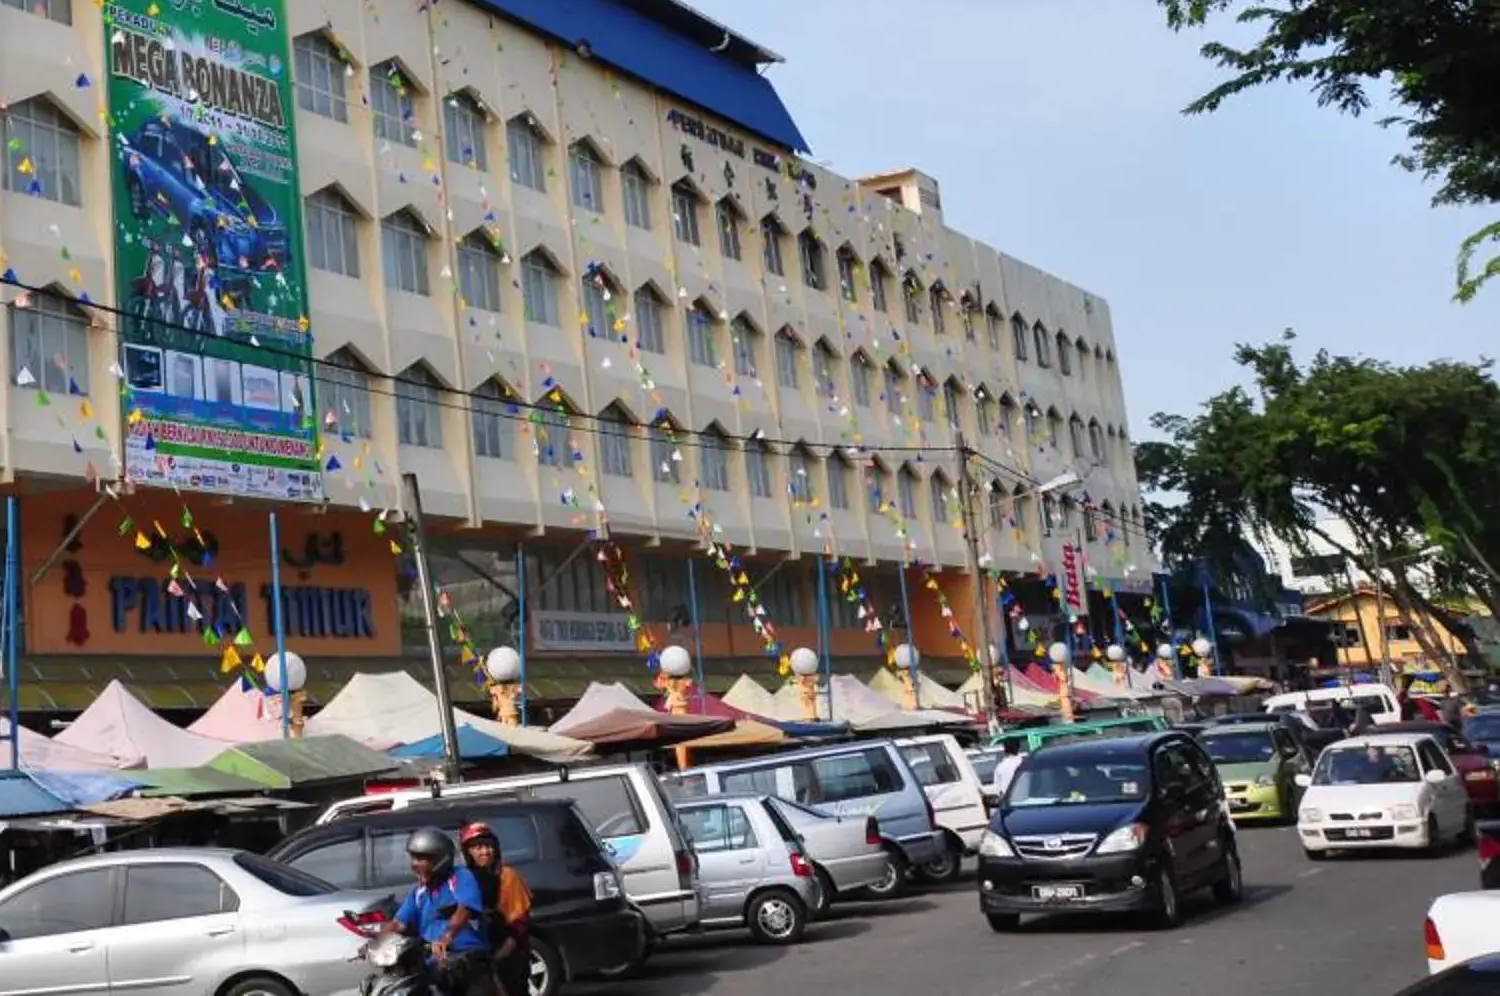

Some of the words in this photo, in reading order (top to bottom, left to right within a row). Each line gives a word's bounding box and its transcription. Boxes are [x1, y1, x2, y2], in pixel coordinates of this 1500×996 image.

[112, 26, 181, 96] MEGA
[180, 51, 285, 127] BONANZA
[110, 575, 248, 635] PANTAI
[262, 582, 376, 638] TIMUR
